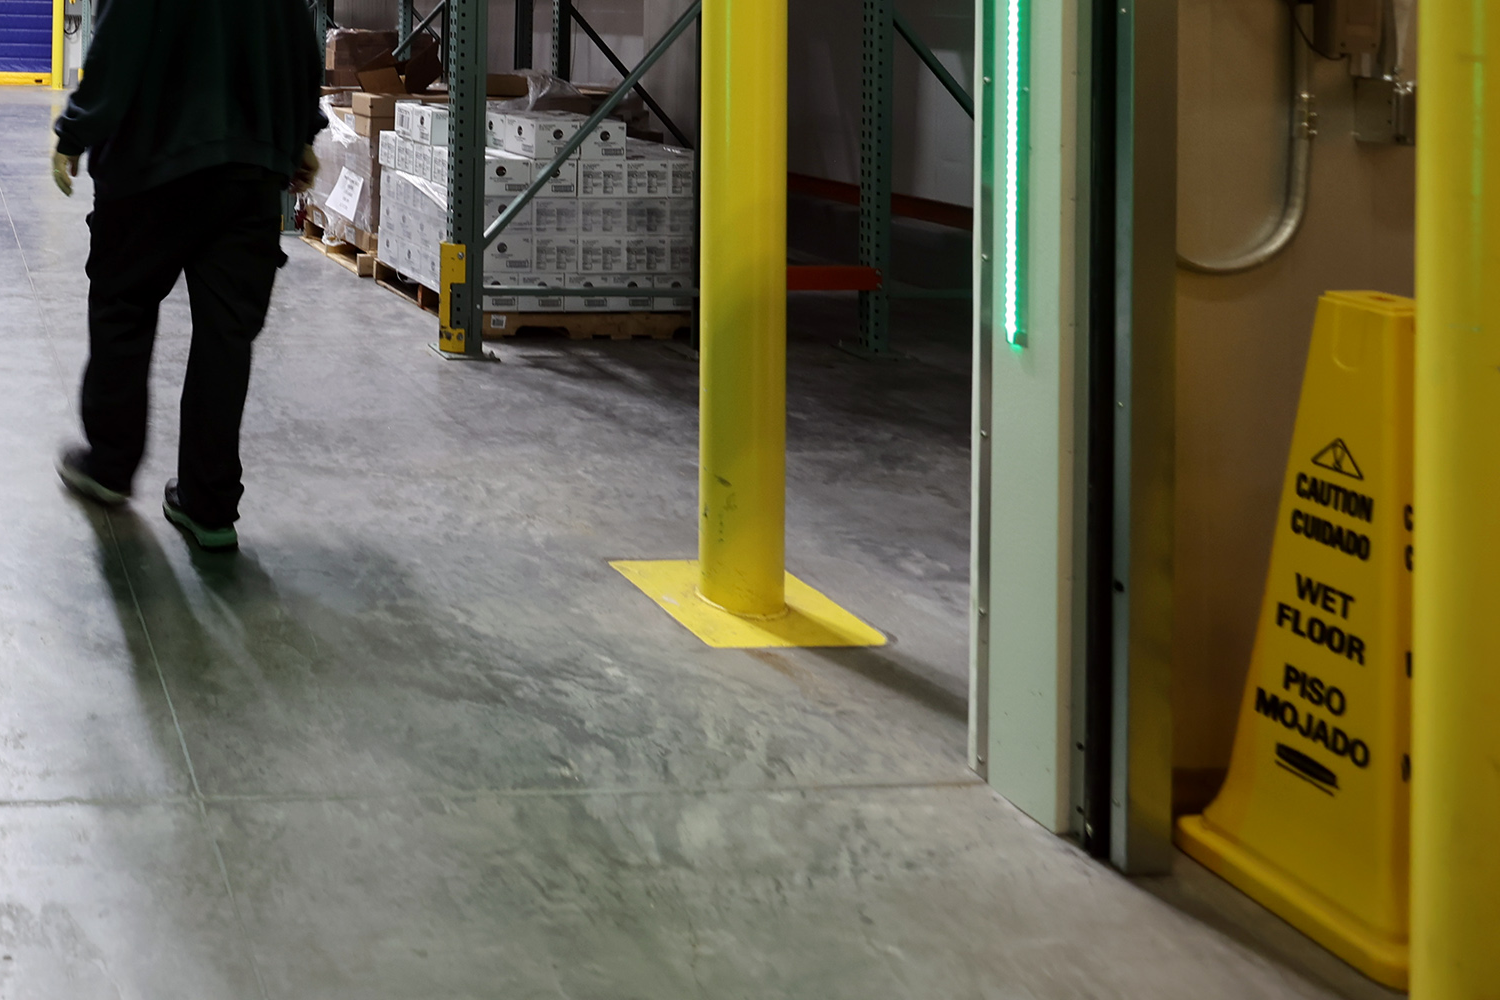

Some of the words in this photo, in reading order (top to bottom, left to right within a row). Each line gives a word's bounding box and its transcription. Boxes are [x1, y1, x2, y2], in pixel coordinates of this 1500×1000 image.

[1295, 471, 1374, 523] CAUTION
[1290, 508, 1371, 561] CUIDADO
[1294, 572, 1355, 620] WET
[1275, 600, 1366, 666] FLOOR
[1282, 663, 1346, 717] PISO
[1253, 687, 1370, 770] MOJADO
